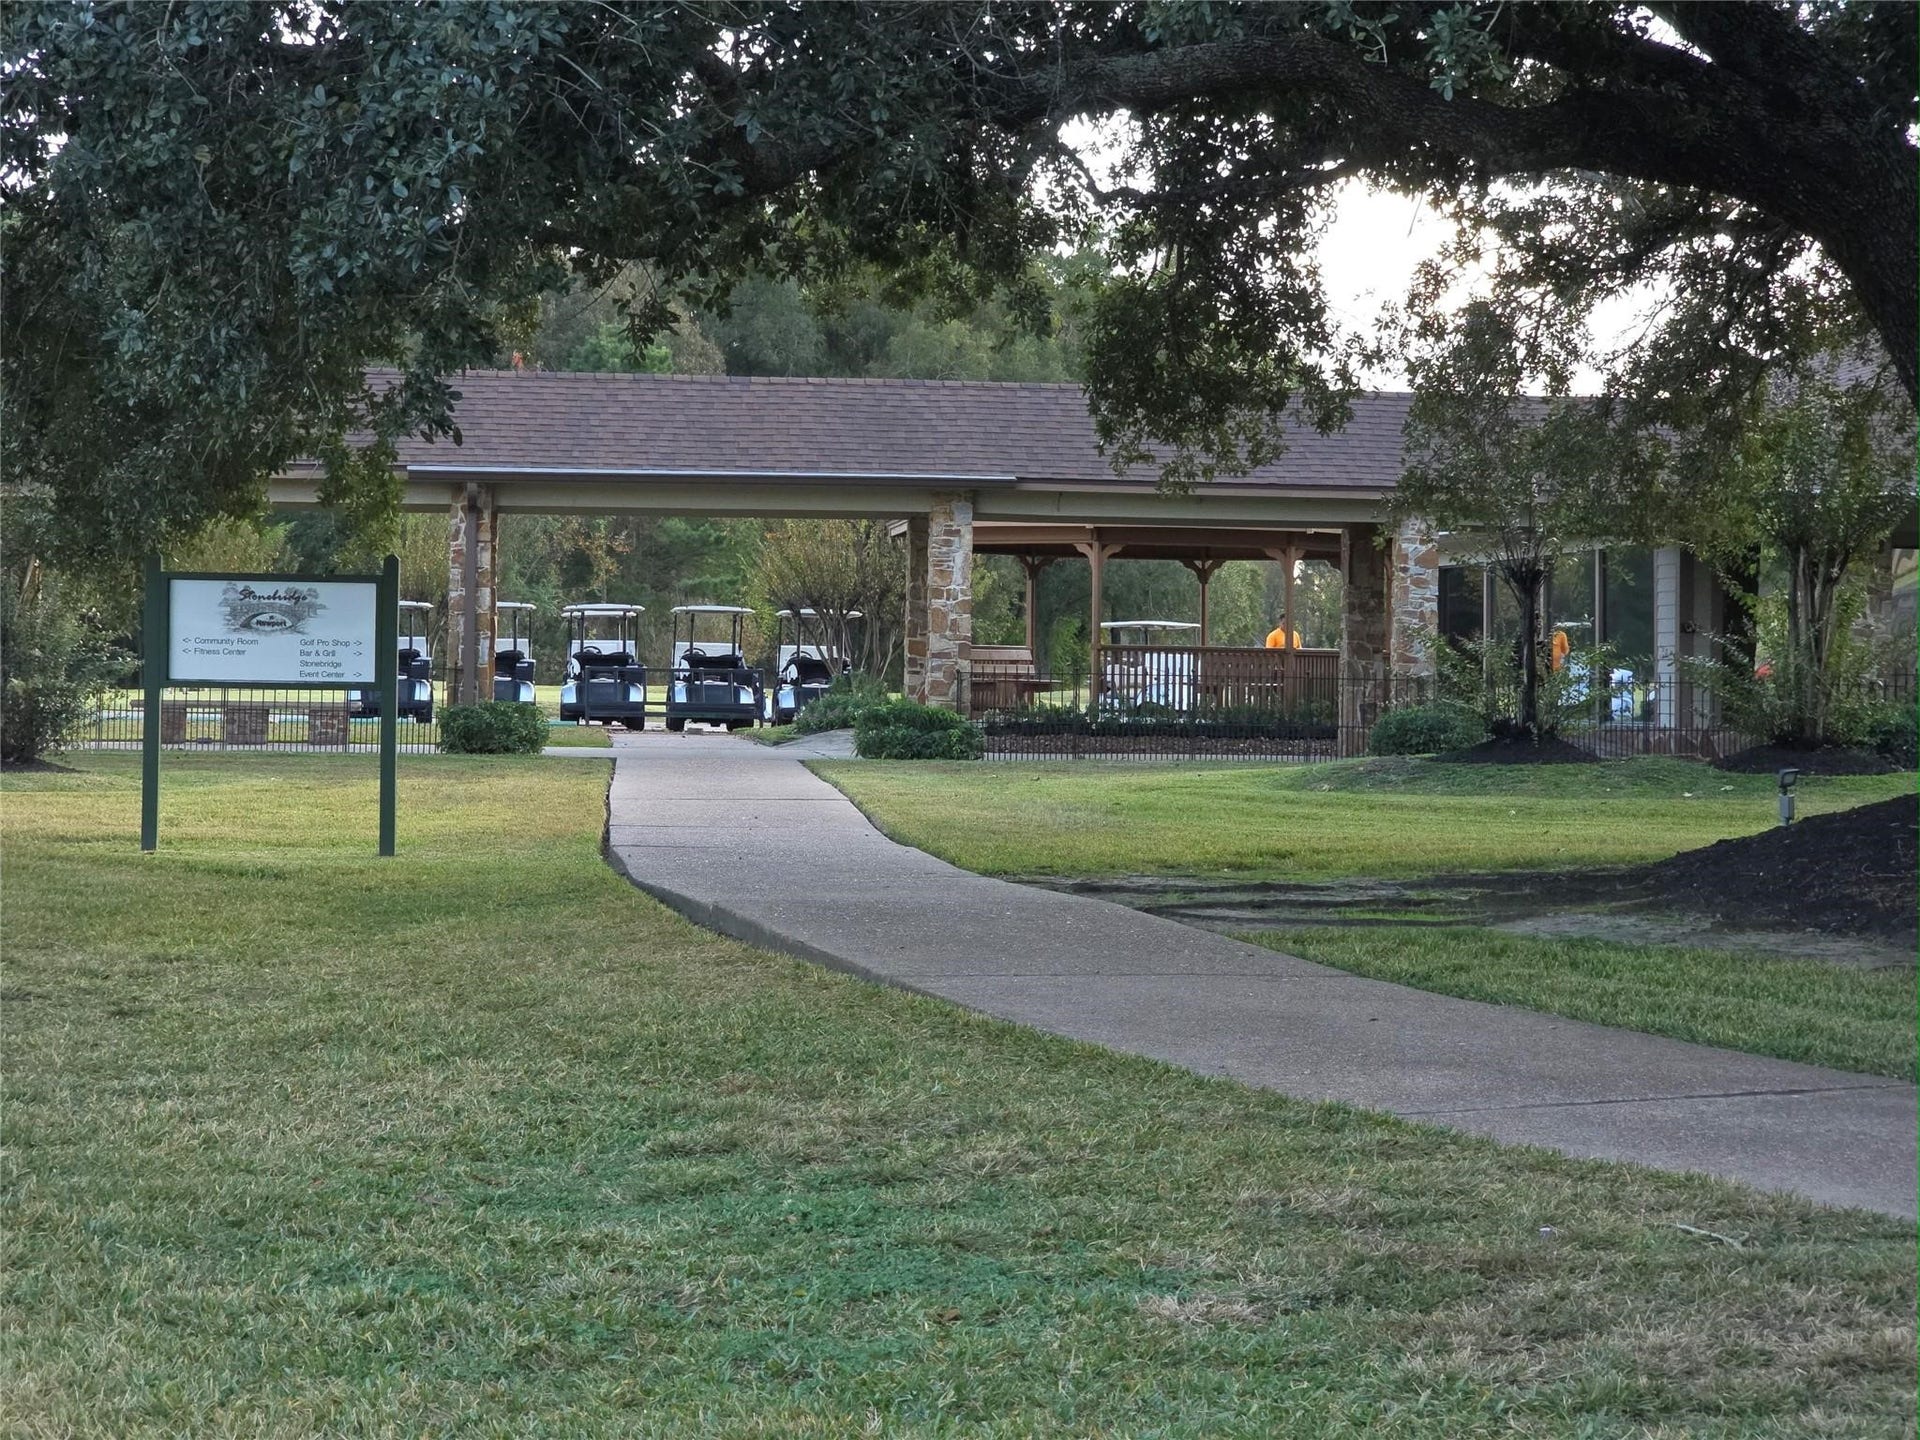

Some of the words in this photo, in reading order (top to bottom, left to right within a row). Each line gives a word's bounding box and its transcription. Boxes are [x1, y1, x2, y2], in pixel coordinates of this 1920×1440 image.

[238, 589, 308, 604] Stonebridge
[194, 637, 234, 646] Community
[331, 640, 350, 648] Shop
[300, 660, 341, 669] Stonebridge
